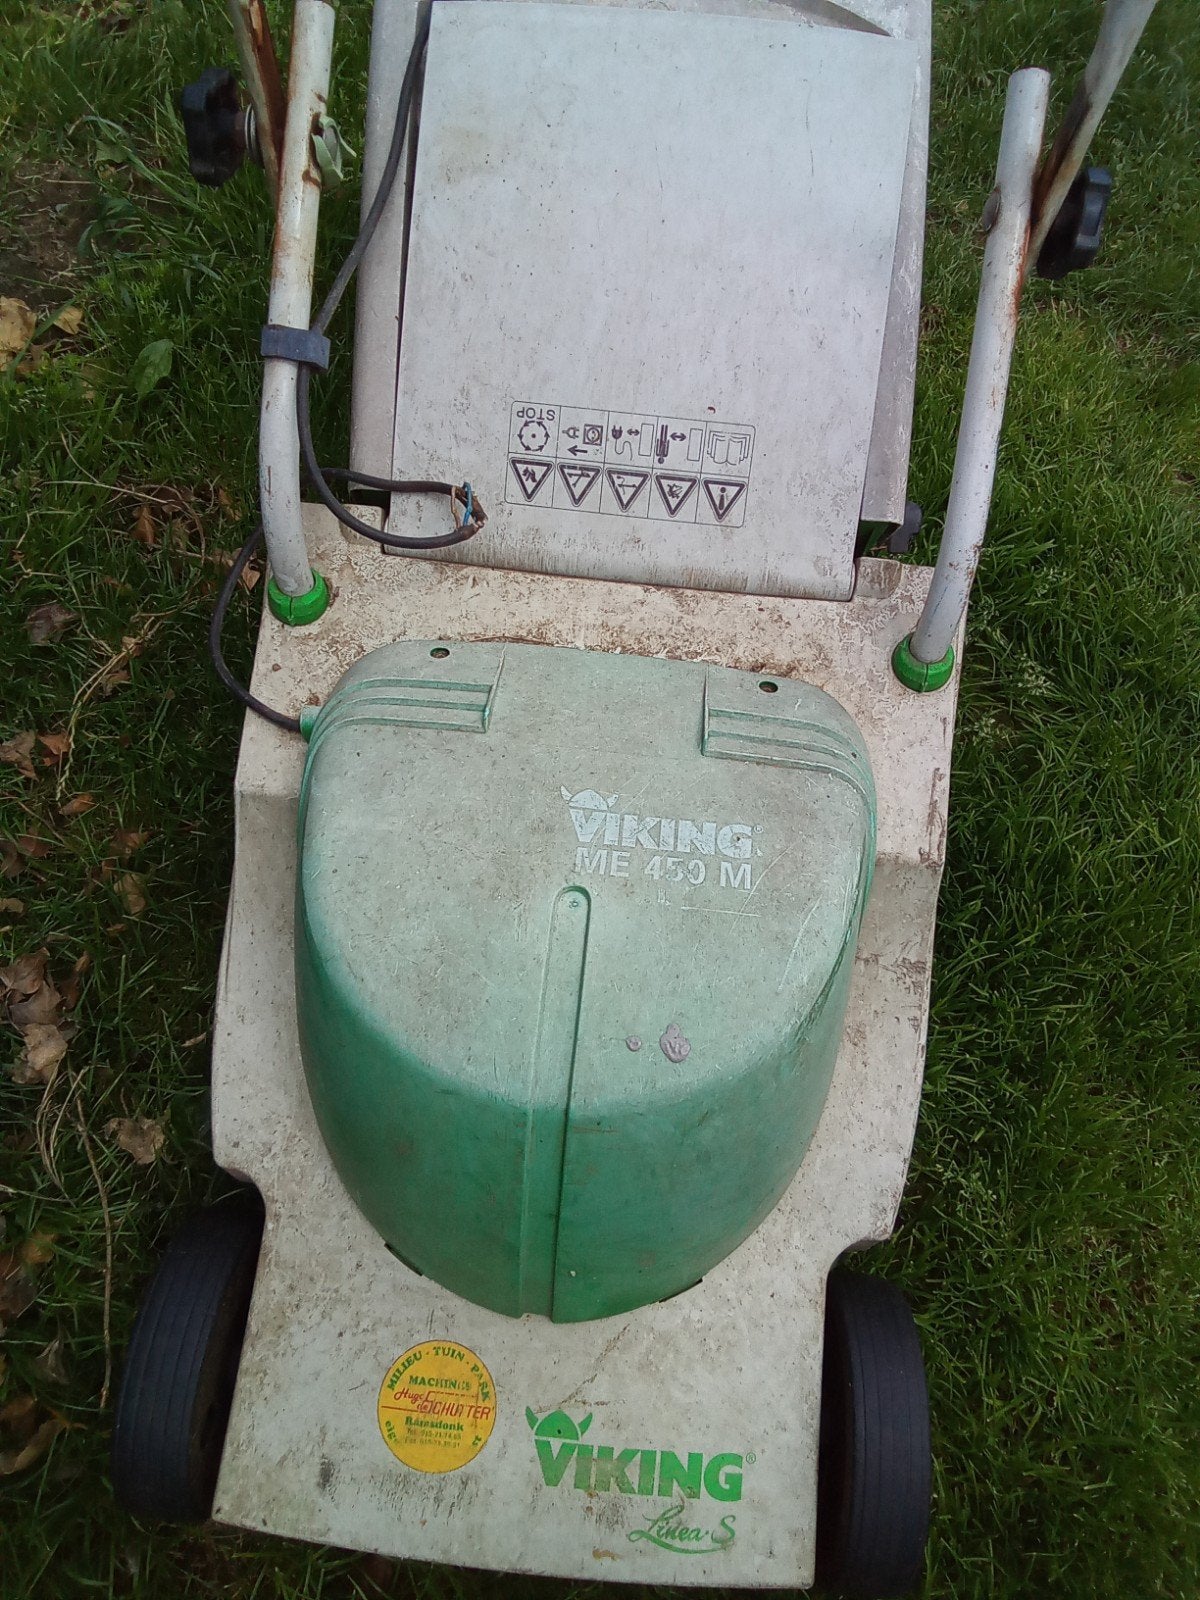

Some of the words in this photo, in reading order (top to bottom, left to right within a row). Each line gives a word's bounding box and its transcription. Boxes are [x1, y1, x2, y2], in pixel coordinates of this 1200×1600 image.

[516, 406, 556, 421] STOP
[568, 808, 753, 859] VIKING
[574, 846, 631, 878] ME
[644, 855, 707, 885] 450
[720, 861, 752, 890] M
[387, 1351, 422, 1390] MILIEU
[432, 1346, 465, 1362] TUIN
[470, 1363, 491, 1402] PARK
[534, 1438, 743, 1503] VIKING
